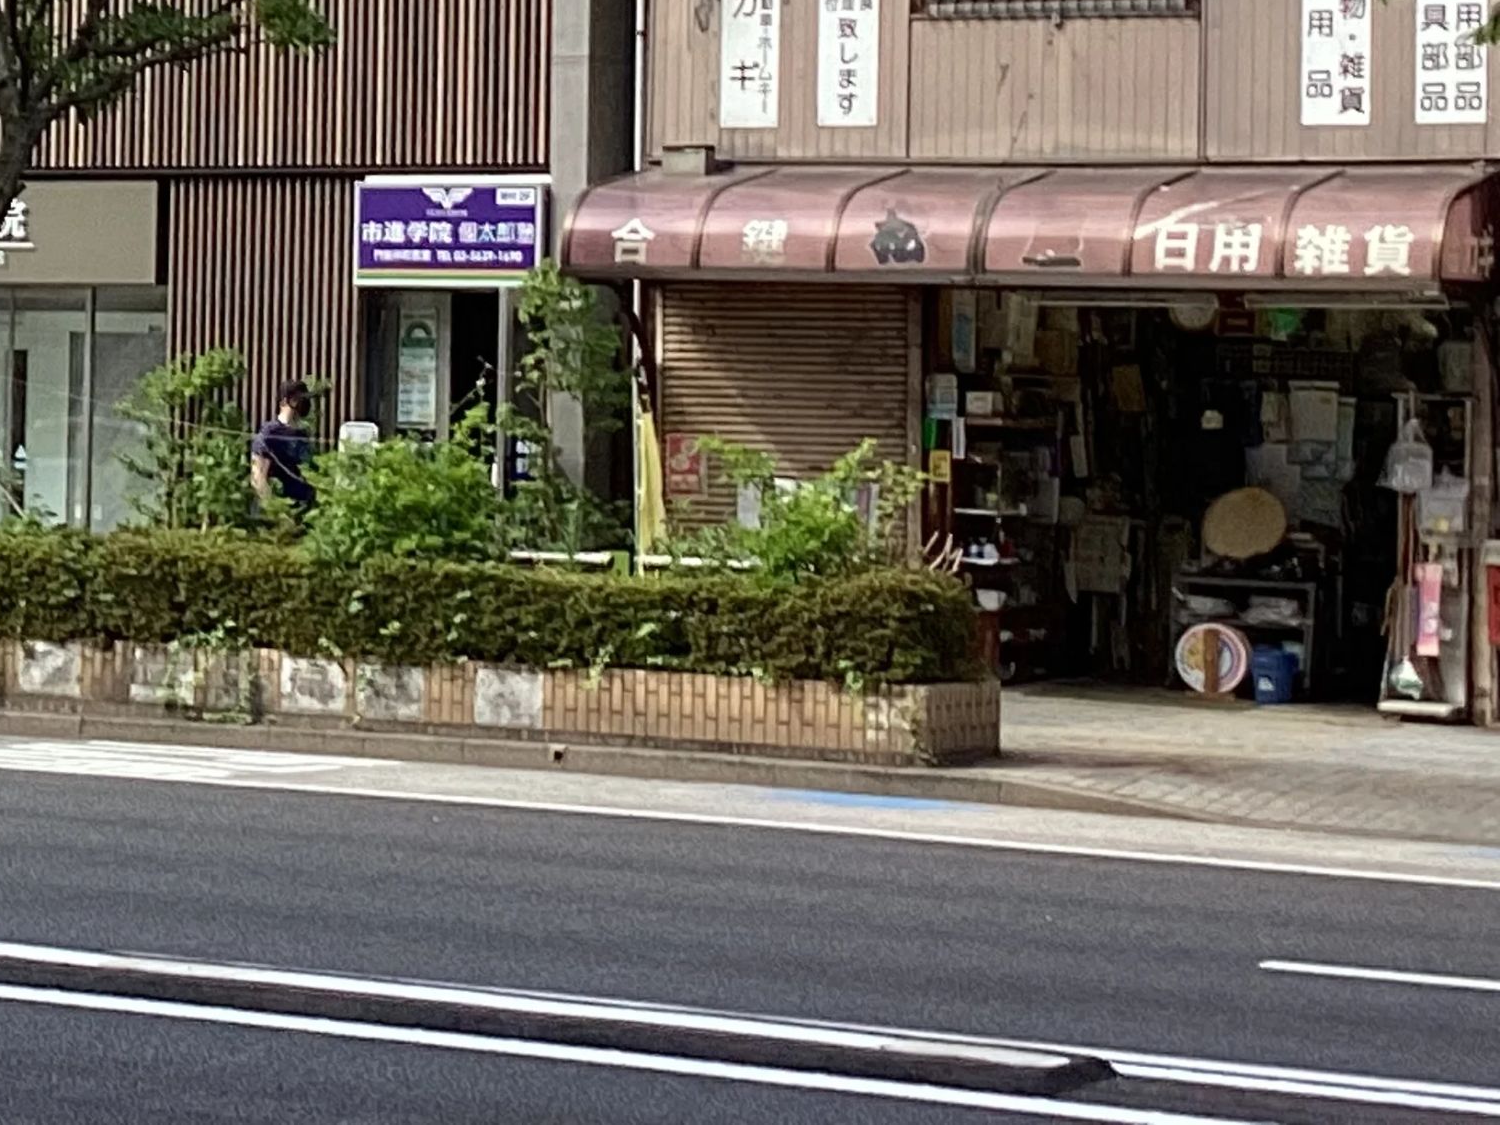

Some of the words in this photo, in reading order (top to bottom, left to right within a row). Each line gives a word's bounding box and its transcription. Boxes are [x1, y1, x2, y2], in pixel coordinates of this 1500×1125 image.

[362, 220, 453, 244] 市進学院
[458, 221, 536, 245] 個太郎塾
